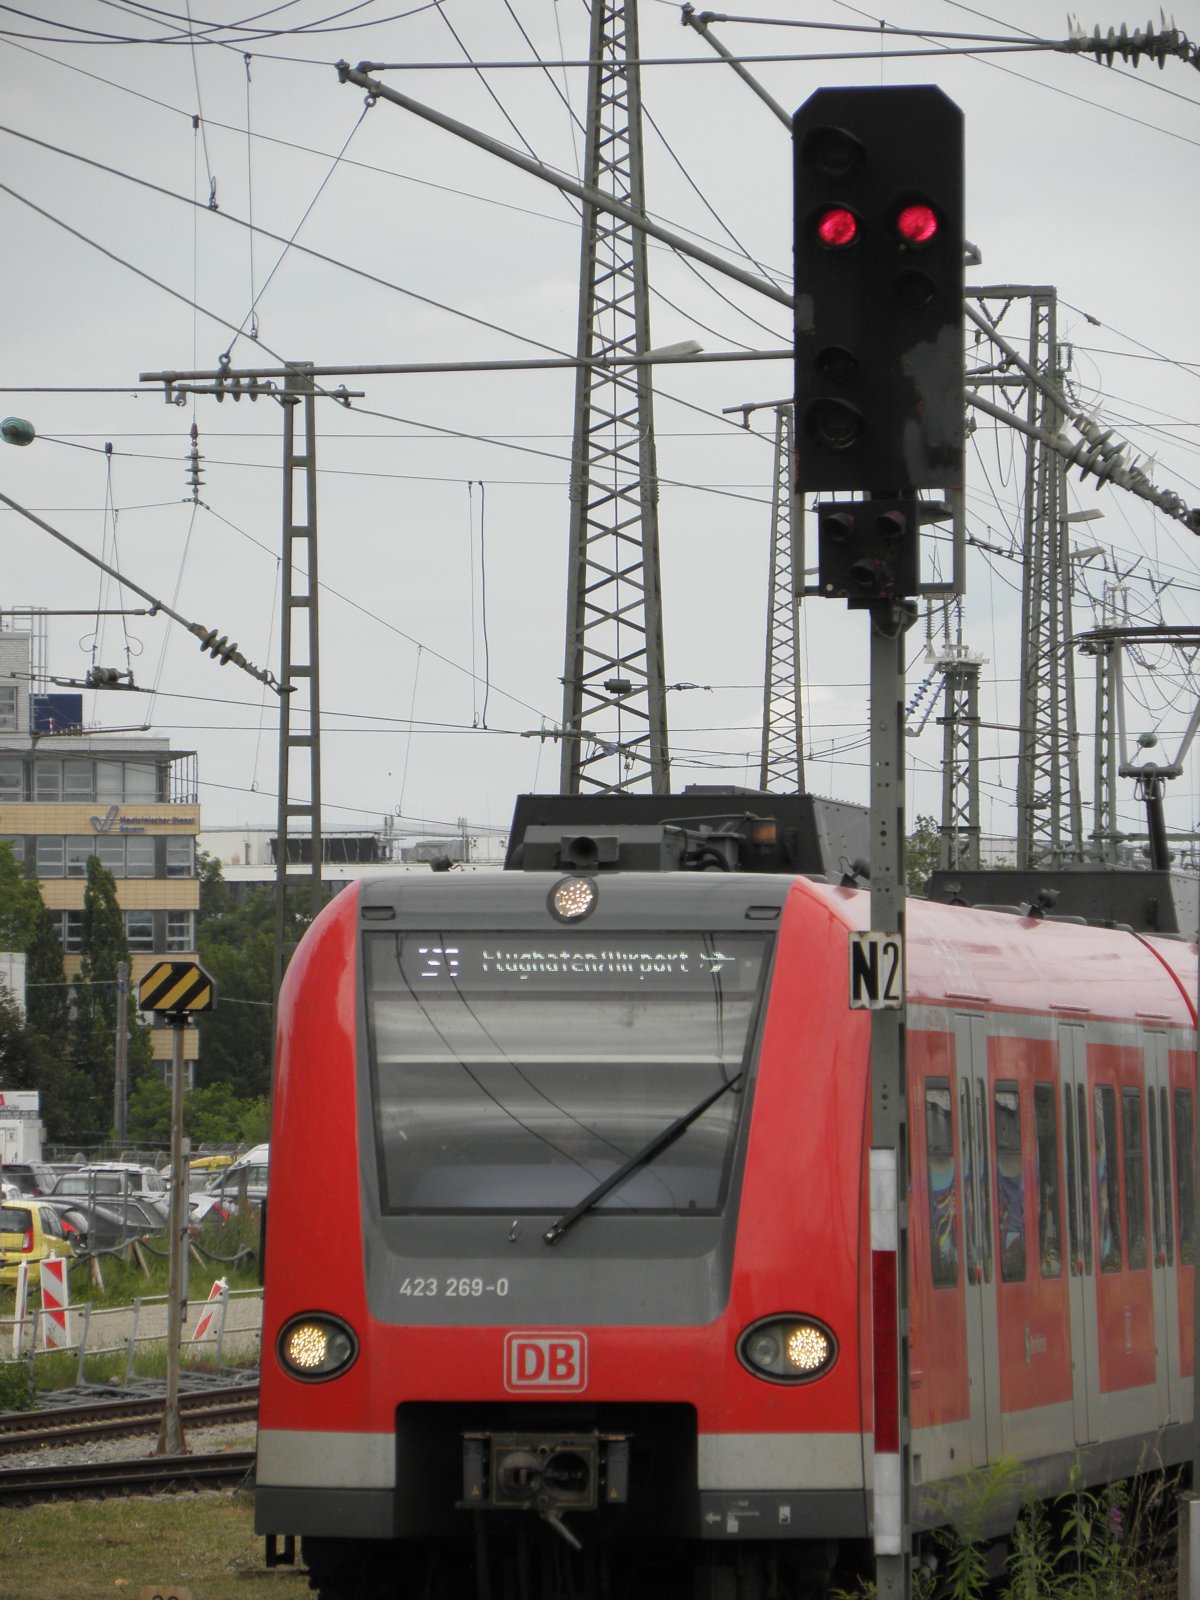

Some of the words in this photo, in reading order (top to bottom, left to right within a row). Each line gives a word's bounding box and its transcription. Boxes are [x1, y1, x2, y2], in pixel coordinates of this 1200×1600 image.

[853, 941, 900, 1000] N2
[400, 1278, 438, 1297] 423
[445, 1278, 509, 1297] 269-0
[517, 1343, 576, 1381] DB
